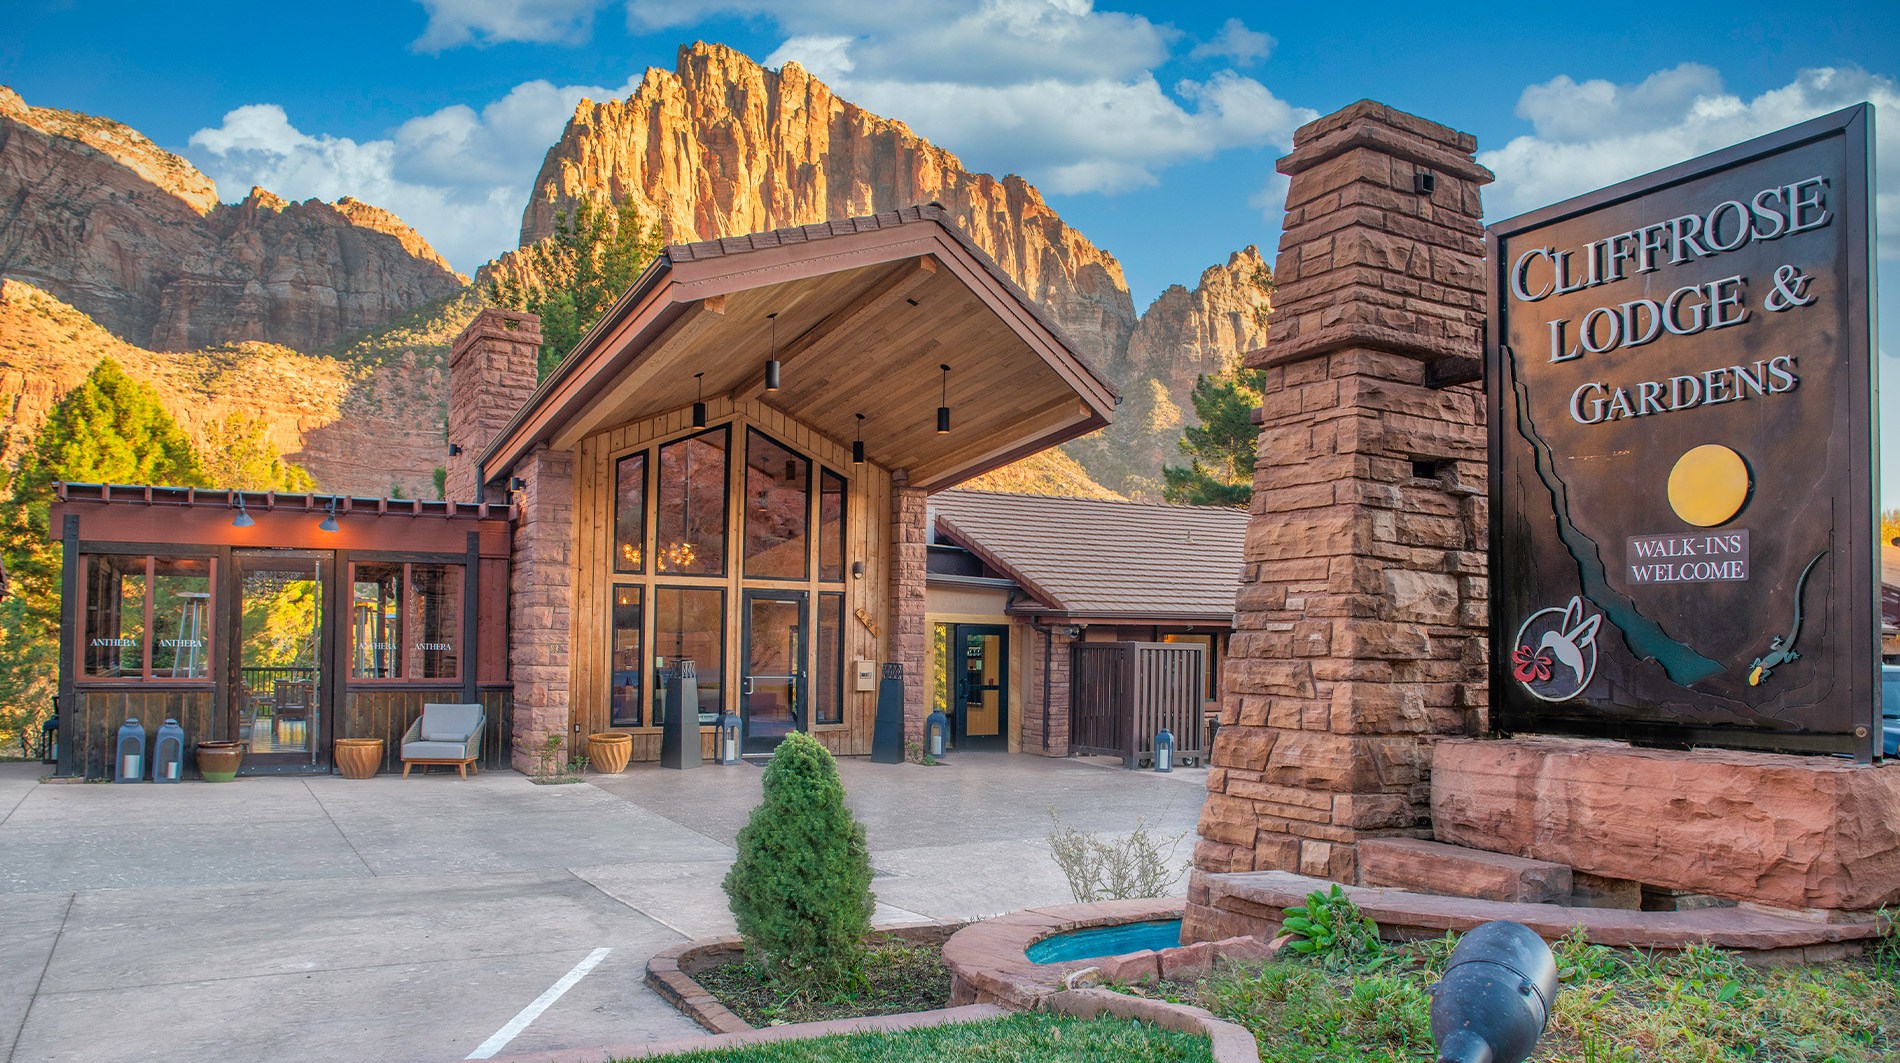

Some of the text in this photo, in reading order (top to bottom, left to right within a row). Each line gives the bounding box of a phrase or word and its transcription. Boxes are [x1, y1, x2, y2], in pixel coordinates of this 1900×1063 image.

[1511, 175, 1829, 302] CLIFFROSE
[1547, 264, 1812, 364] LODGE &
[1569, 354, 1795, 425] GARDENS
[1633, 535, 1741, 557] WALK-INS
[1631, 560, 1744, 581] WELCOME
[91, 638, 136, 647] ANTHERA
[159, 639, 202, 648] ANTHERA
[415, 643, 451, 651] ANTHERA
